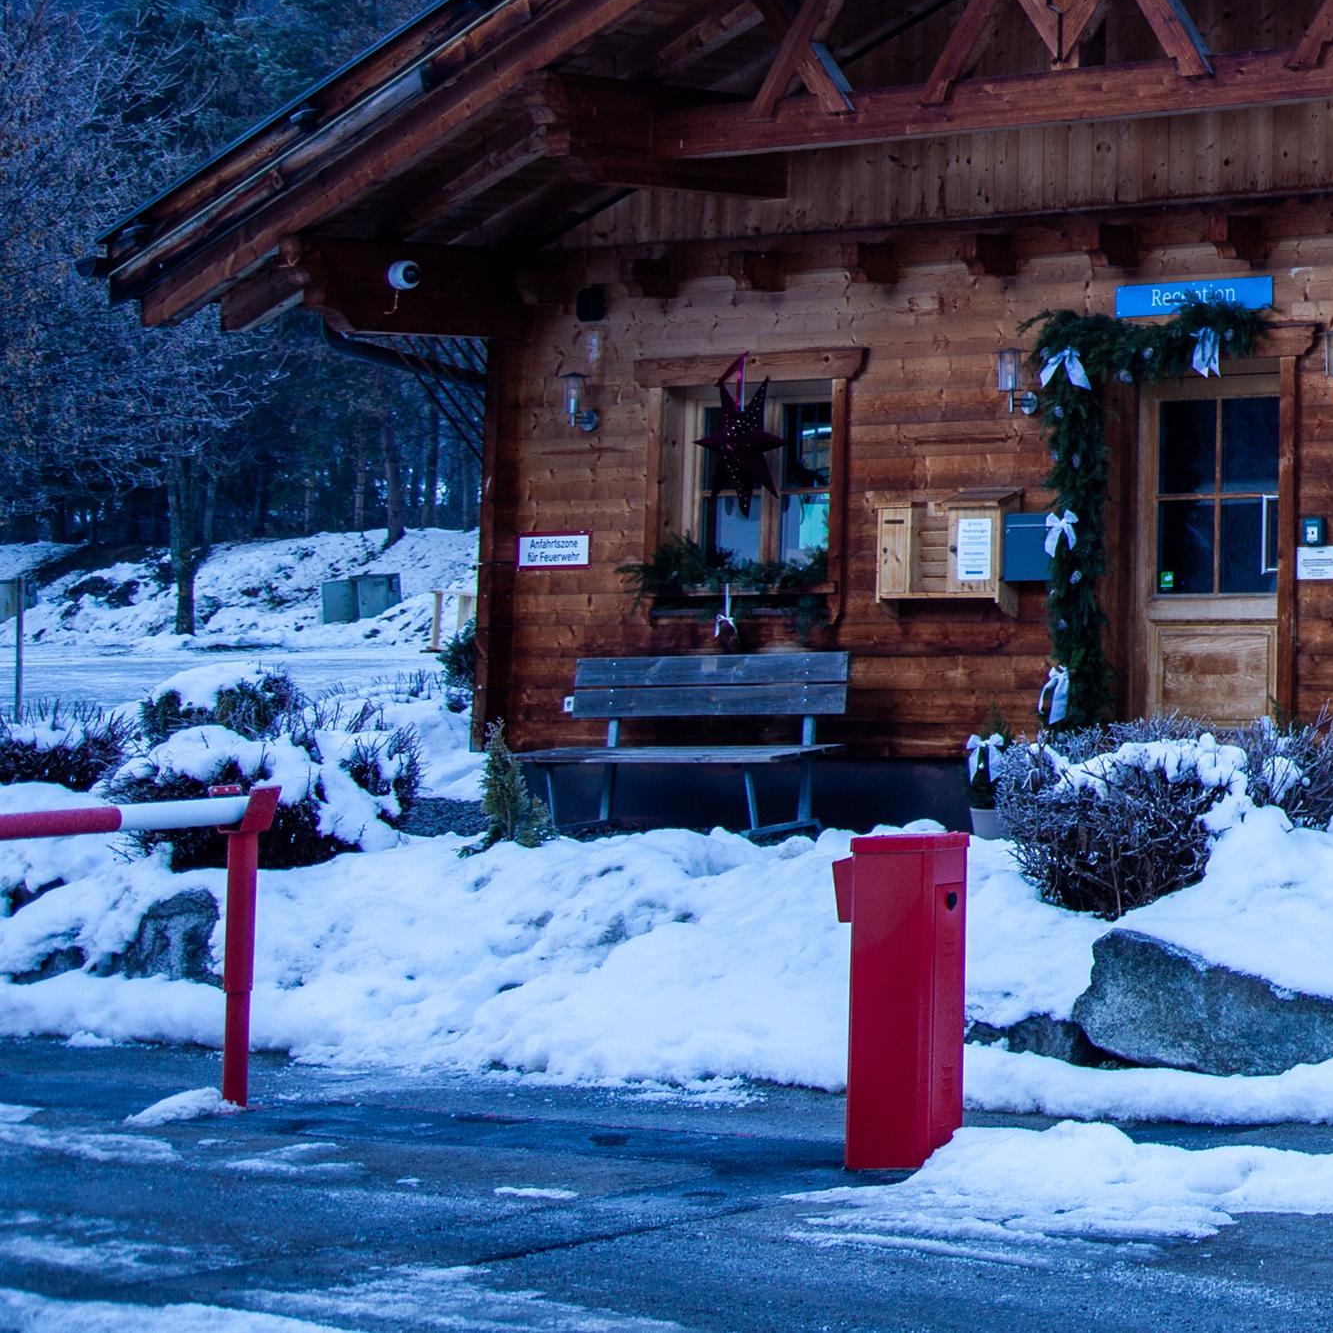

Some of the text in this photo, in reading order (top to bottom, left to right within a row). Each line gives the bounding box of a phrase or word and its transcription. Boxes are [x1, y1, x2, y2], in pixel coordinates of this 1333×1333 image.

[1151, 283, 1236, 307] Rection
[529, 539, 578, 549] Anfahrtszone
[527, 551, 580, 563] für Feuerwehr
